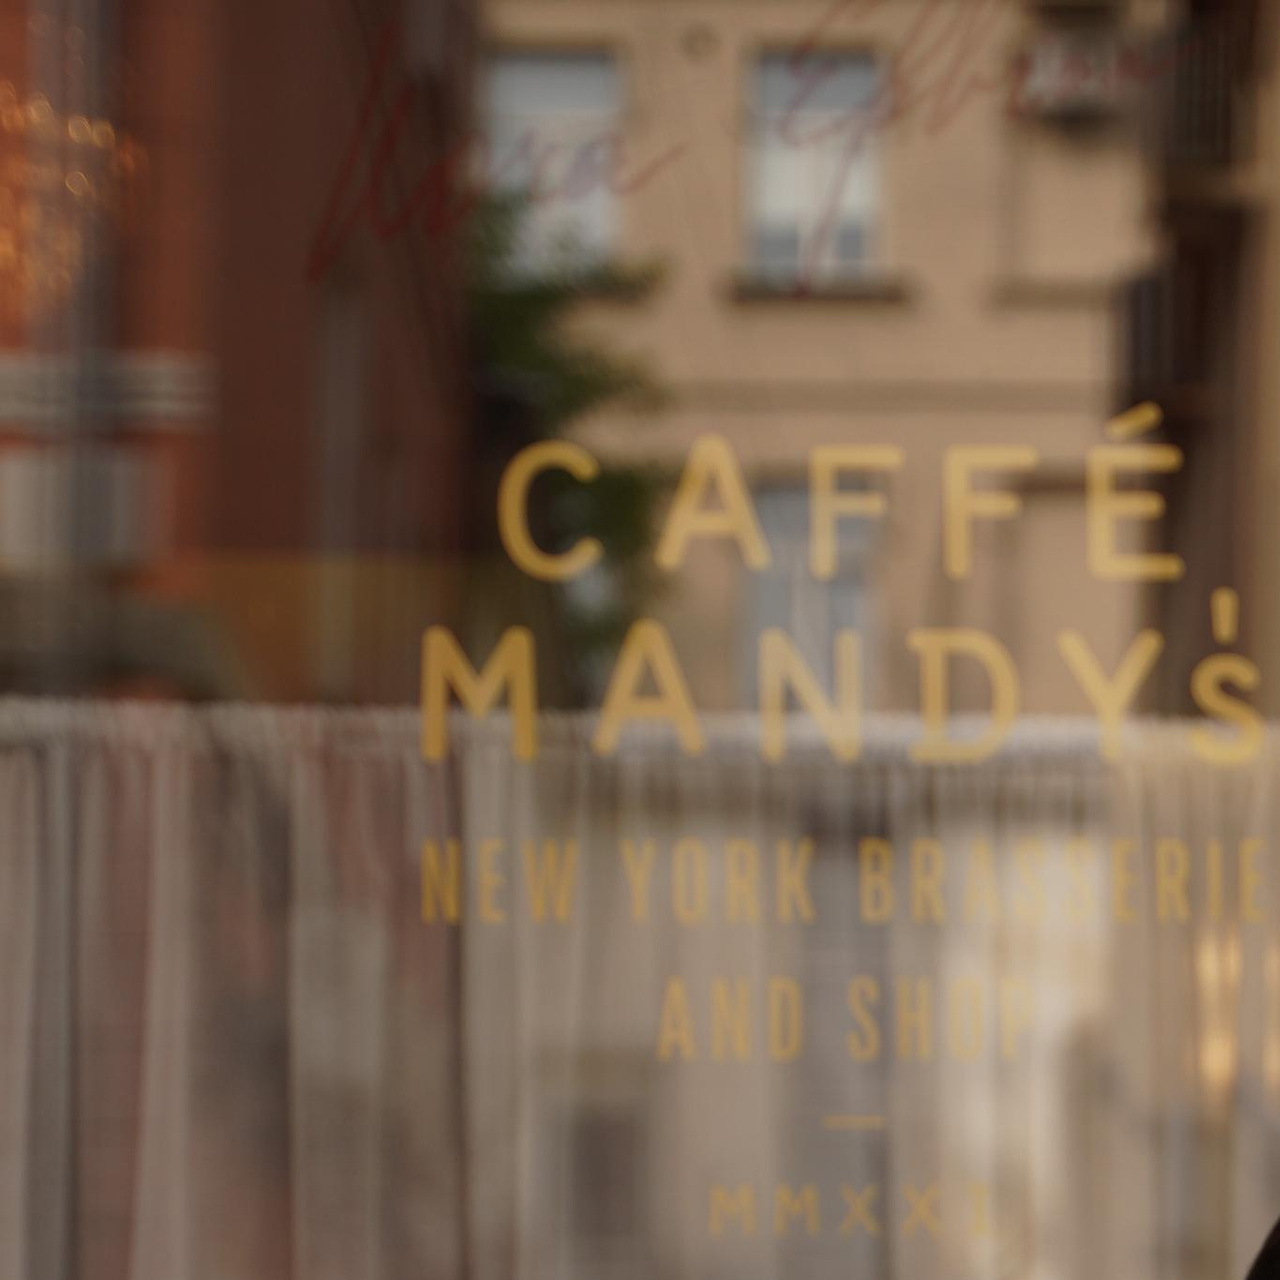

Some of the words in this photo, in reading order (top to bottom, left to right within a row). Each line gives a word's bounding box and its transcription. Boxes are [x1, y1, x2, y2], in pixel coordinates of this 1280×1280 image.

[497, 403, 1186, 580] CAFFÉ
[420, 835, 580, 926] NEW
[619, 835, 818, 926] YORK
[857, 835, 1270, 926] BRASSERIE
[655, 976, 806, 1063] AND
[845, 976, 1035, 1063] SHOP
